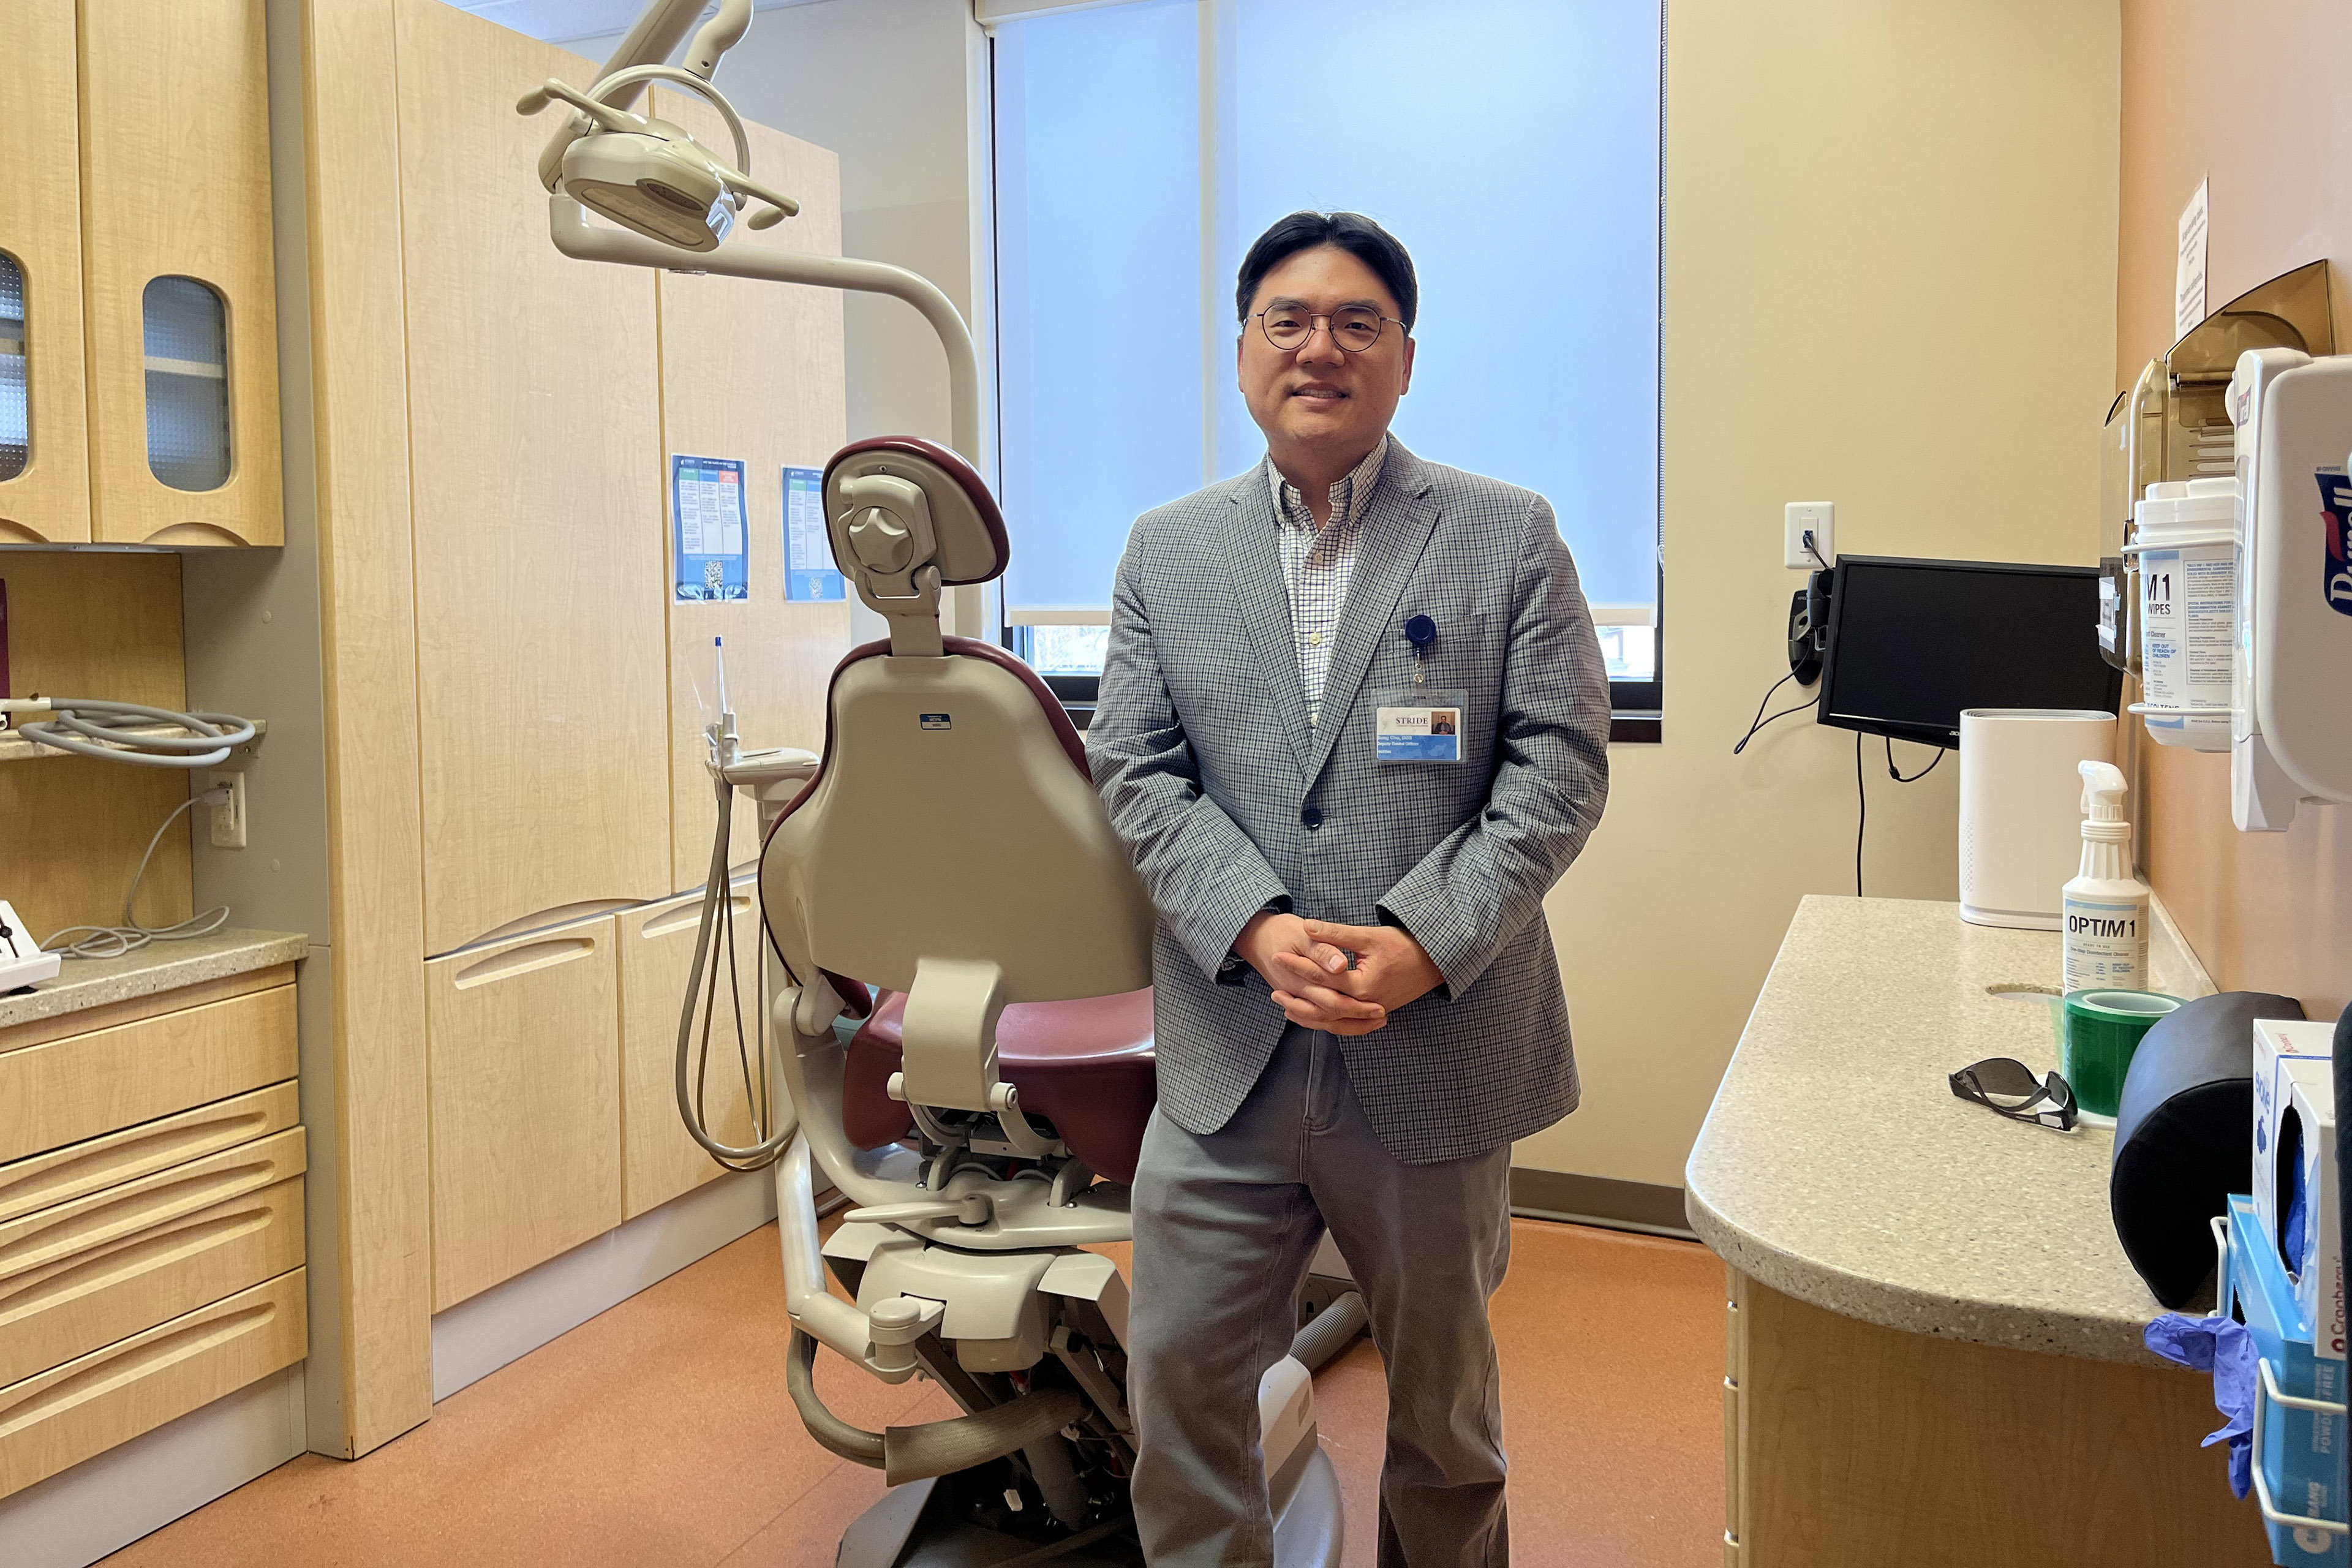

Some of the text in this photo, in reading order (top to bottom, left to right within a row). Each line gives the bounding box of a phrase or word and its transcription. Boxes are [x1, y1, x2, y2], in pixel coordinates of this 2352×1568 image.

[2162, 574, 2170, 601] 1
[2069, 915, 2135, 938] OPTIM 1
[2320, 1365, 2335, 1454] POWD-FREE
